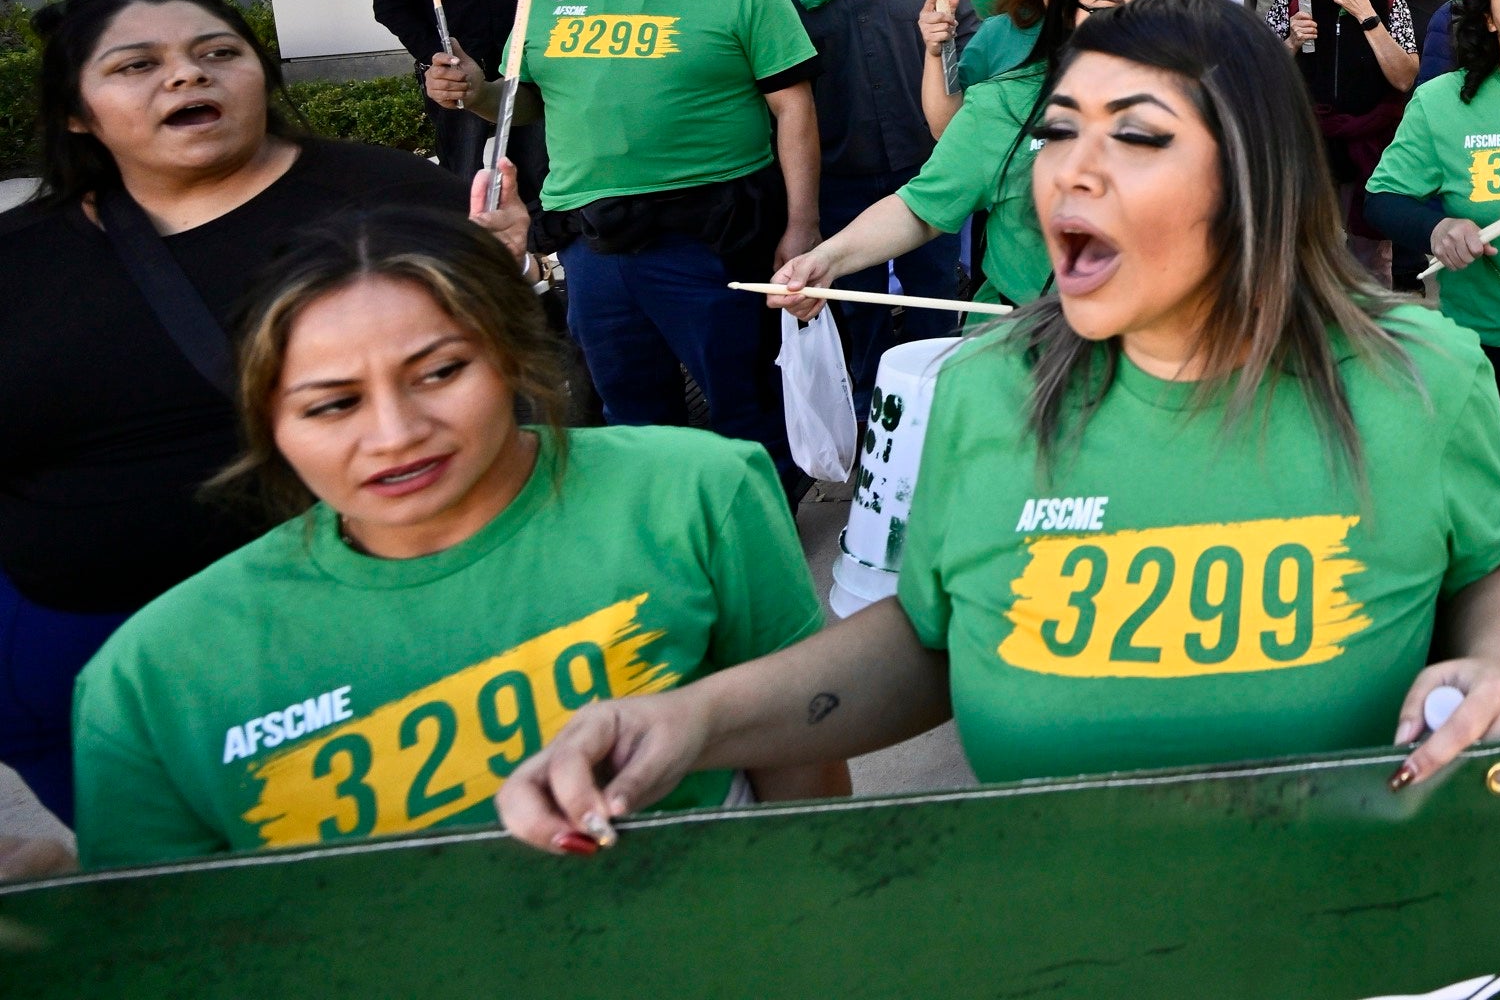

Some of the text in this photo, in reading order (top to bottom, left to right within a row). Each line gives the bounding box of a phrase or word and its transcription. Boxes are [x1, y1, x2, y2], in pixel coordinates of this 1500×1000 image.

[553, 5, 588, 16] AFSCME
[560, 19, 659, 57] 3299
[1015, 496, 1109, 532] AFSCME
[1040, 543, 1315, 664] 3299
[222, 685, 353, 764] AFSCME
